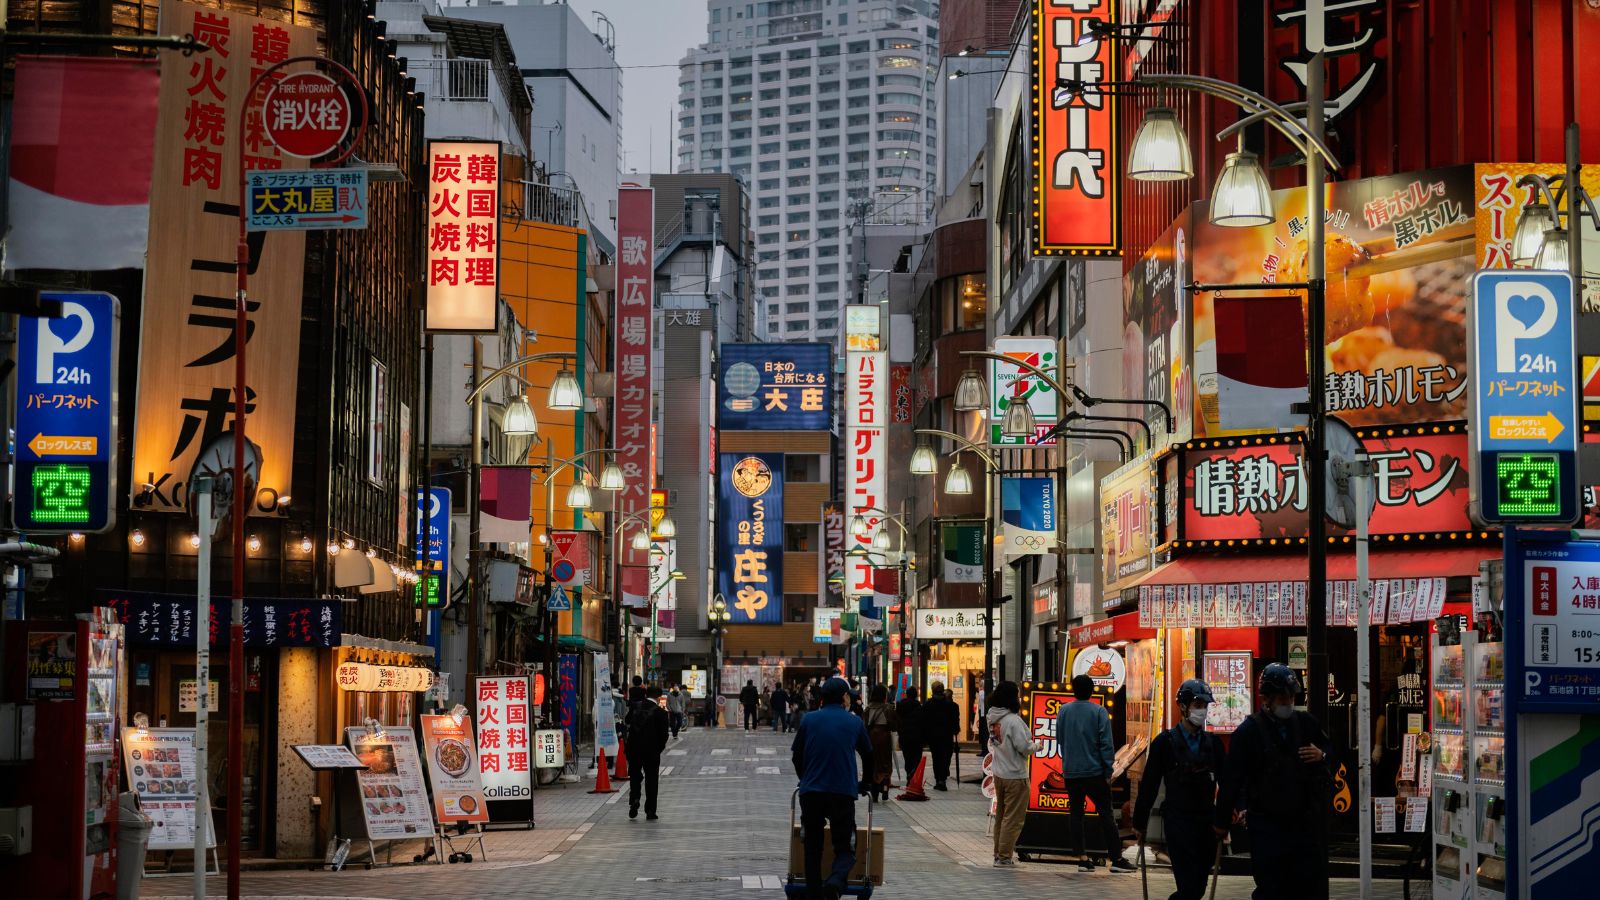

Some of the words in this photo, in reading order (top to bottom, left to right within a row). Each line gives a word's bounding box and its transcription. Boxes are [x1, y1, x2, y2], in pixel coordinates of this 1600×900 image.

[183, 11, 231, 190] 炭火焼肉
[279, 84, 296, 93] FIRE
[299, 84, 334, 94] HYDRANT
[272, 98, 342, 131] 消火栓
[254, 187, 335, 214] 大丸屋
[338, 187, 363, 211] 買入
[252, 215, 295, 226] ここ入る
[430, 153, 461, 286] 炭火焼肉
[465, 153, 497, 286] 韓国料理
[667, 310, 701, 326] 大雄
[55, 366, 91, 385] 24h
[764, 361, 796, 373] 日本の
[1518, 354, 1558, 374] 24h
[774, 372, 826, 385] 台所になる
[858, 356, 875, 424] パチスロ
[1487, 379, 1566, 398] パークネット
[26, 393, 100, 410] パークネット
[764, 388, 824, 412] 大庄
[31, 464, 91, 523] 空
[1195, 448, 1459, 516] 情熱ホモン
[1497, 453, 1558, 513] 空
[1042, 483, 1051, 509] TOKYO
[752, 499, 765, 545] くつろぎ
[1043, 510, 1052, 529] 2020
[733, 548, 768, 620] 庄や
[1571, 594, 1600, 609] 4時
[138, 610, 150, 634] チキン
[349, 666, 359, 685] 炭火
[479, 681, 501, 773] 炭火焼肉
[505, 680, 528, 773] 韓国料理
[544, 733, 555, 764] 豊田屋
